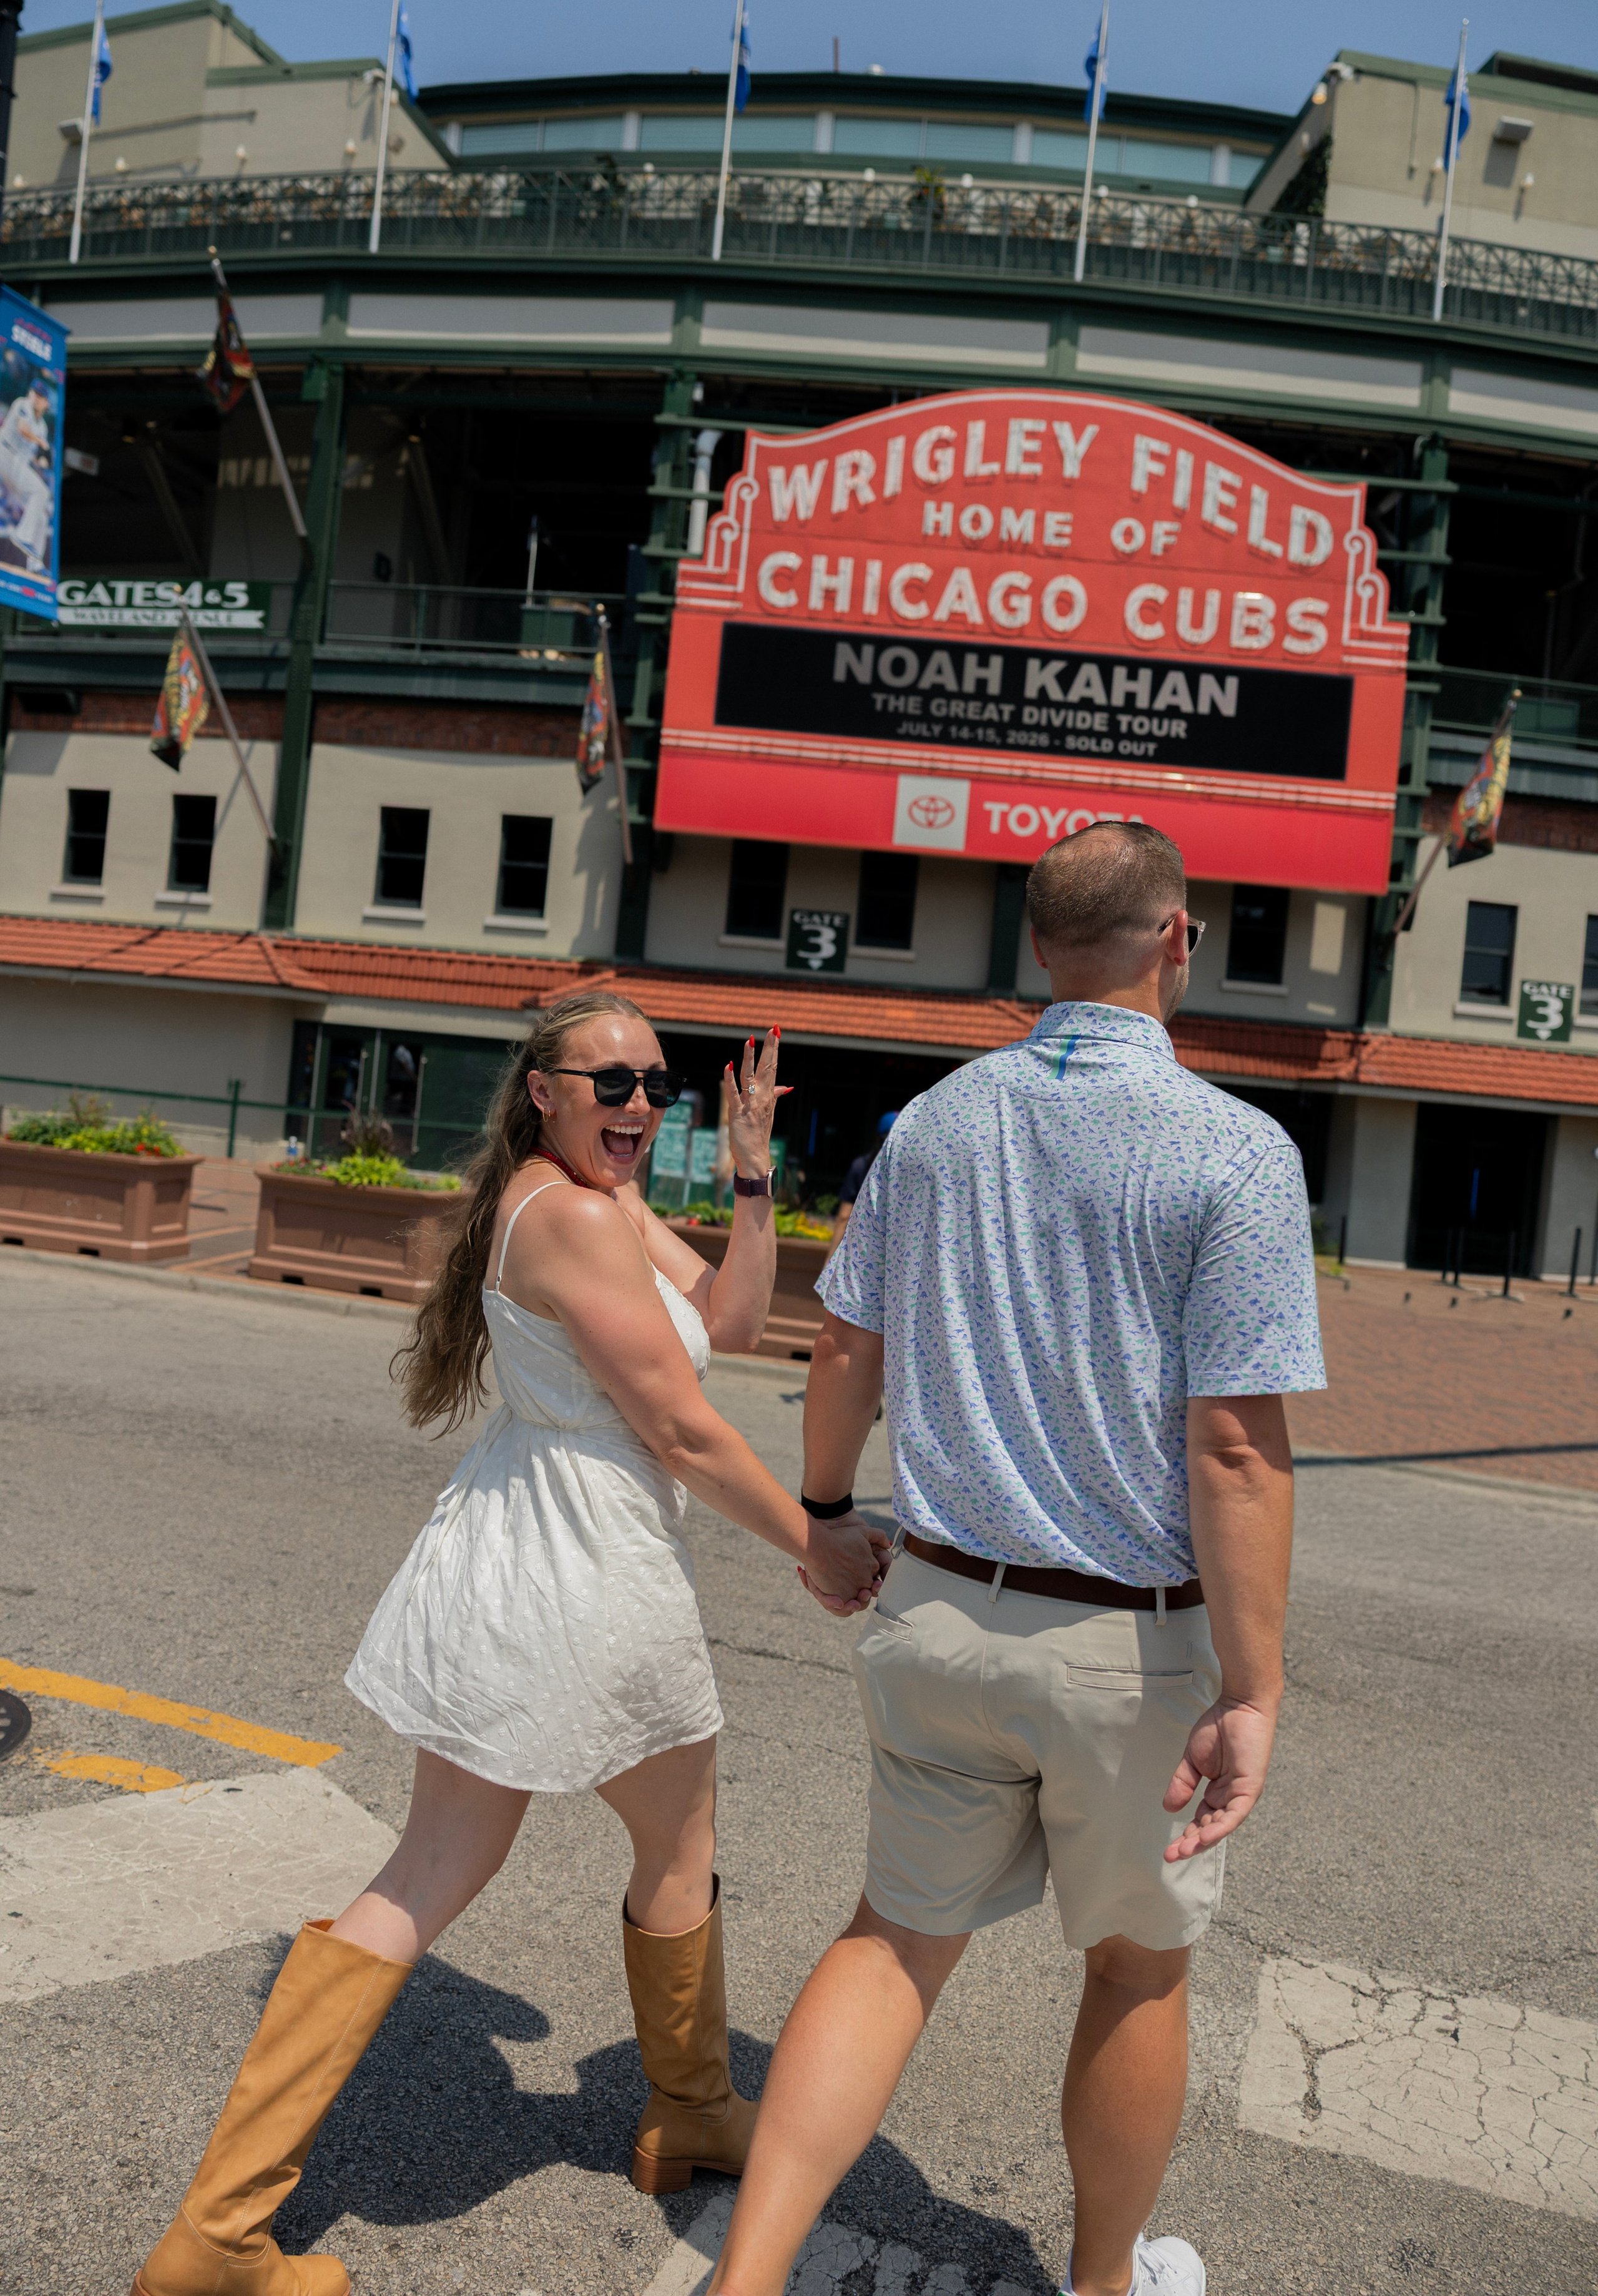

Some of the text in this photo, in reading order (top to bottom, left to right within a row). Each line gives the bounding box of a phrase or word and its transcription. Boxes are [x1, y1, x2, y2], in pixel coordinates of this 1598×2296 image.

[768, 418, 1334, 567] WRIGLEY FIELD
[922, 501, 1181, 556] HOME OF
[56, 579, 181, 607] GATES
[757, 551, 1330, 655] CHICAGO CUBS
[833, 642, 1239, 717] NOAH KAHAN
[872, 692, 1187, 739] THE GREAT DIVIDE TOUR
[897, 721, 943, 738] JULY
[1006, 729, 1051, 748] 2026
[1064, 735, 1114, 754] SOLD
[1118, 739, 1159, 757] OUT
[983, 801, 1144, 839] TOYO
[793, 911, 846, 928] GATE
[797, 925, 836, 959] 3
[1523, 981, 1573, 999] GATE
[1526, 994, 1563, 1030] 3
